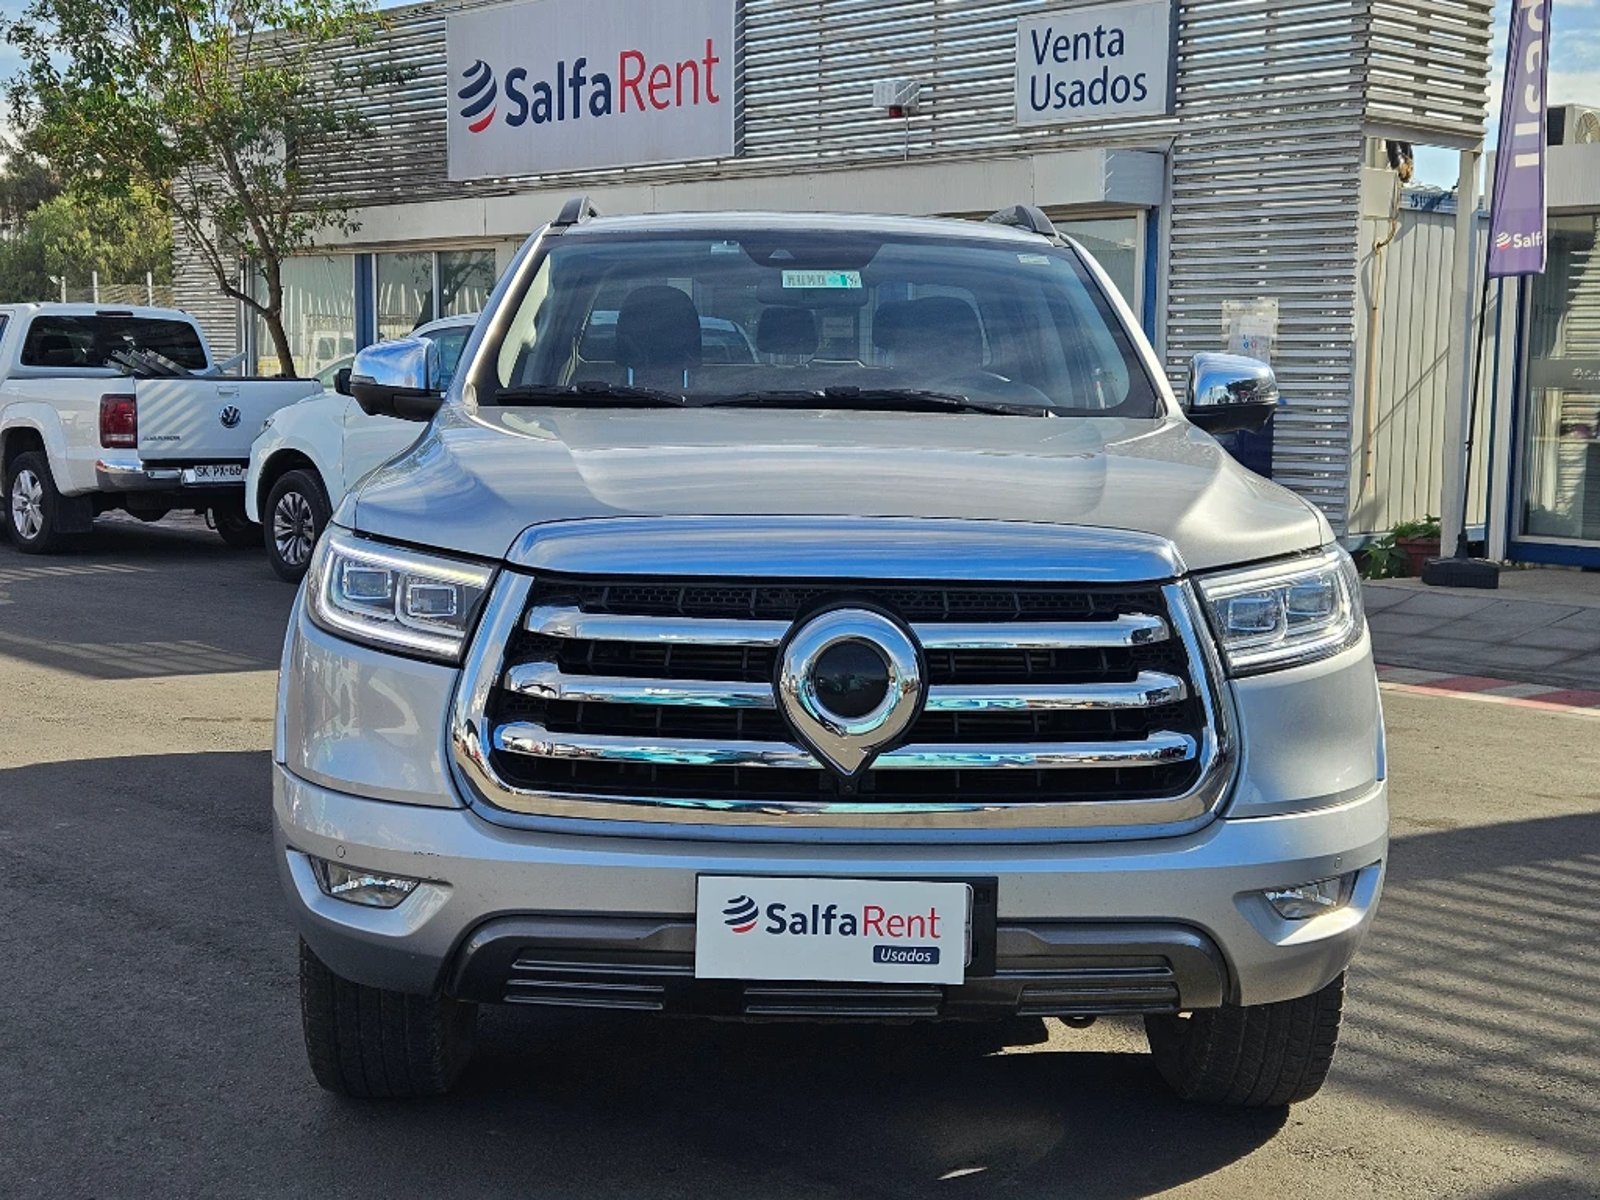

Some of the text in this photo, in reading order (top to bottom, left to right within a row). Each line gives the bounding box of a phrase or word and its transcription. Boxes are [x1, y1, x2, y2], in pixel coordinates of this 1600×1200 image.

[1031, 24, 1125, 65] Venta
[504, 38, 720, 127] SalfaRent
[1030, 65, 1148, 112] Usados
[765, 903, 942, 939] SalfaRent
[880, 948, 932, 963] Usados
